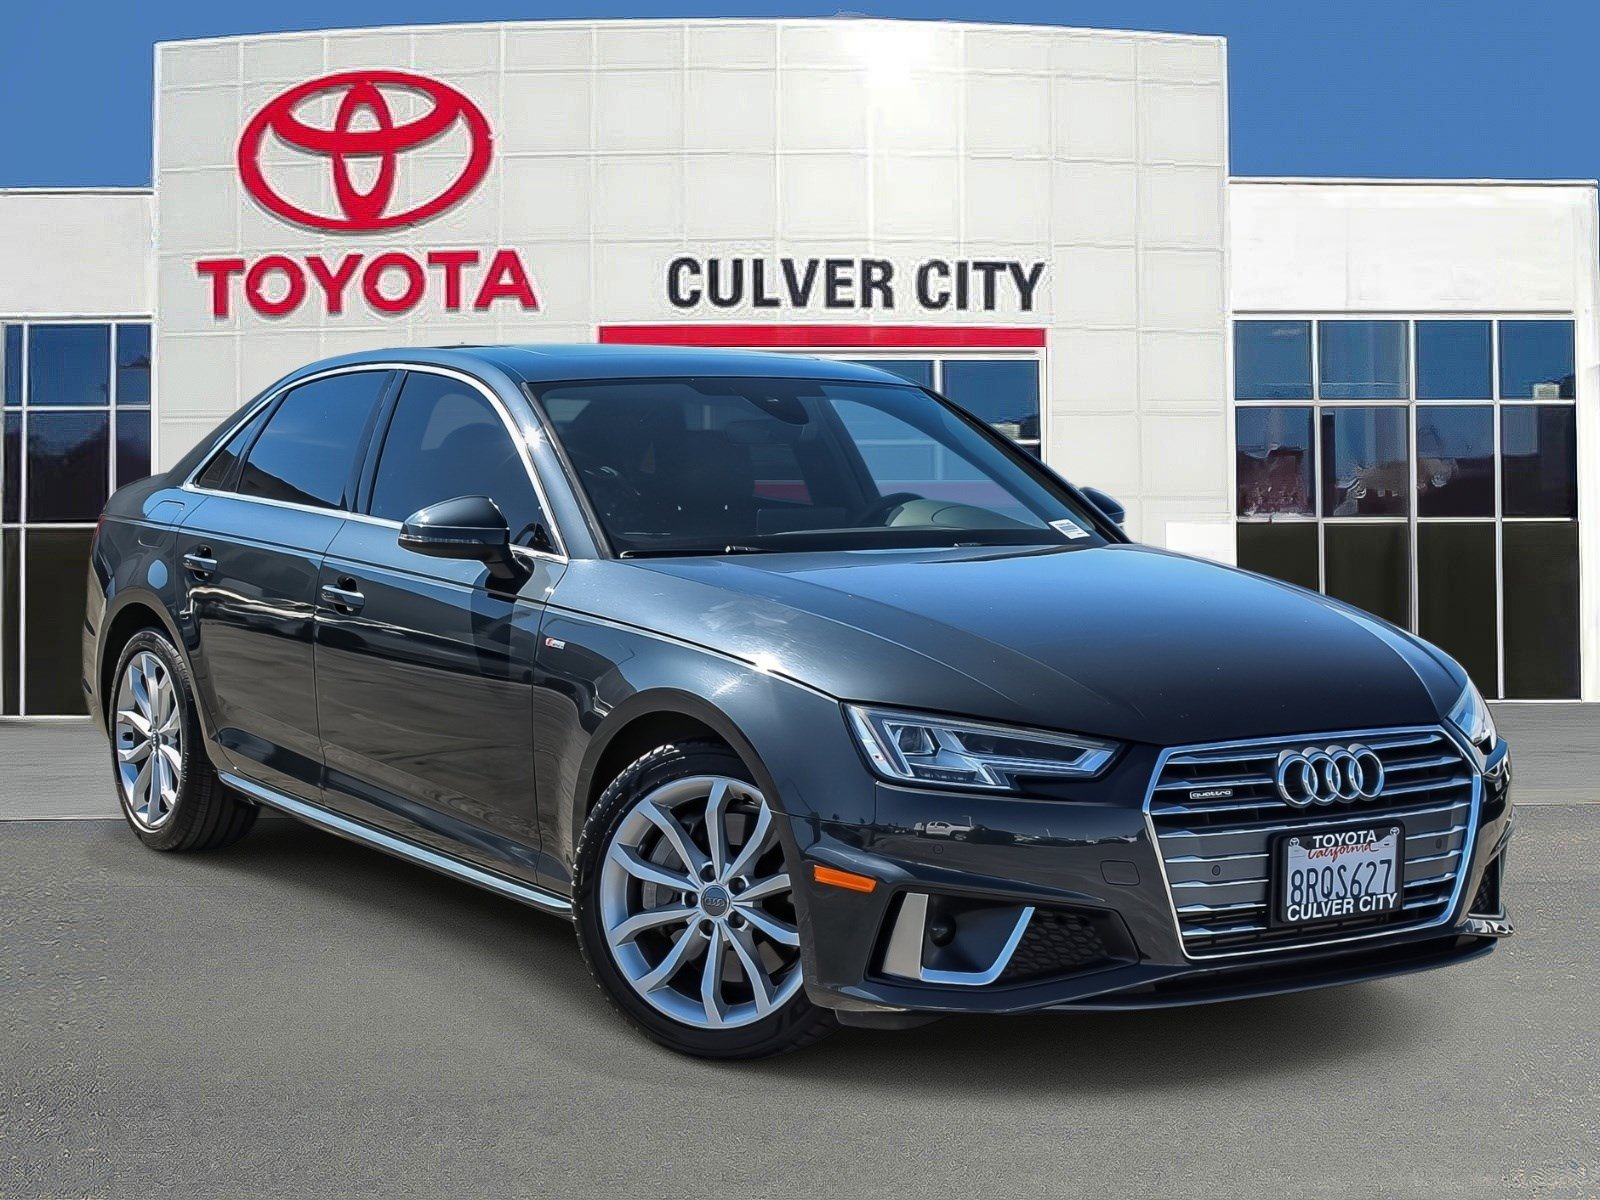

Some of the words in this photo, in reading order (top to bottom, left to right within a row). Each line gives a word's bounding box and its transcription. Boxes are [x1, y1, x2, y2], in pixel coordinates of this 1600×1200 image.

[196, 249, 538, 319] TOYOTA
[668, 257, 895, 309] CULVER
[915, 259, 1046, 311] CITY
[1192, 790, 1231, 798] quattro
[1307, 841, 1379, 863] California
[1312, 829, 1377, 849] TOYOTA
[1290, 858, 1393, 905] 8RQS627
[1287, 898, 1355, 921] CULVER
[1359, 892, 1398, 912] CITY
